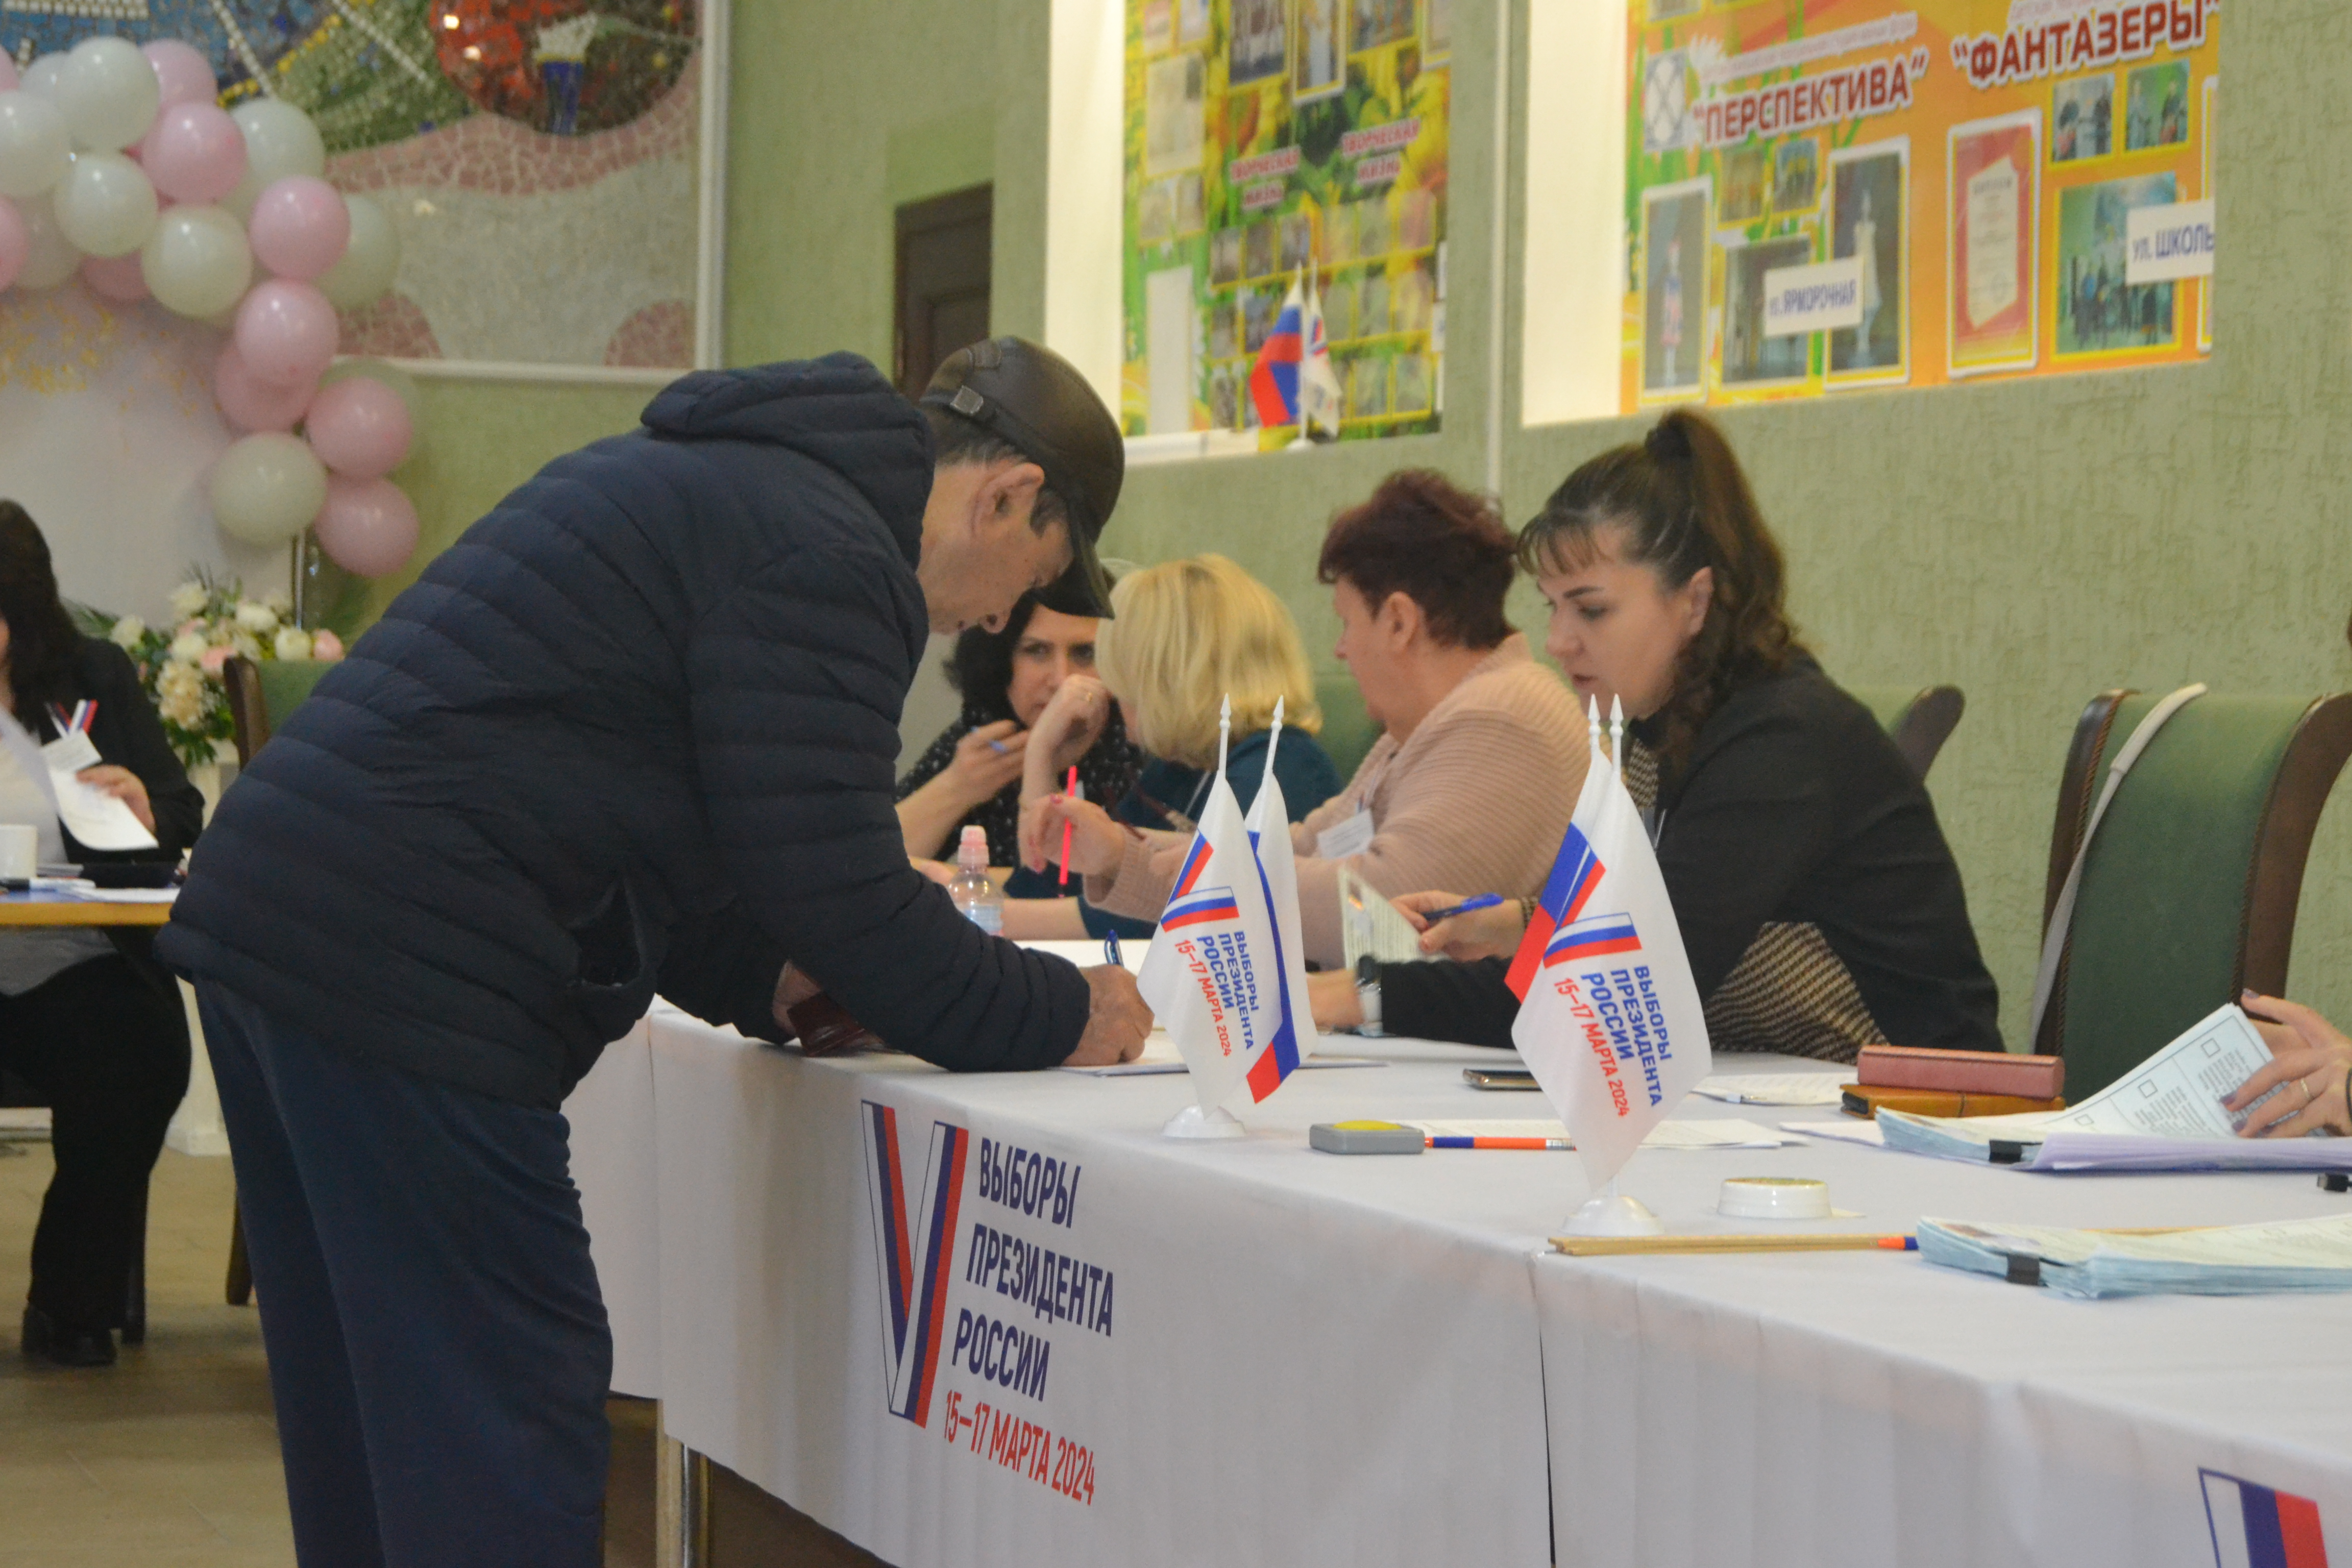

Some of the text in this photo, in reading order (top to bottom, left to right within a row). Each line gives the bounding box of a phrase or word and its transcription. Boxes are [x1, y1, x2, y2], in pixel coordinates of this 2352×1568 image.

[1196, 935, 1235, 1008] РОССИИ
[1197, 977, 1224, 1023] МАРТА
[1216, 1025, 1232, 1057] 2024
[1218, 933, 1254, 1049] ПРЕЗИДЕНТА
[1234, 931, 1260, 1011] ВЫБОРЫ
[1580, 972, 1634, 1059] РОССИИ
[1634, 966, 1673, 1060] ВЫБОРЫ
[1581, 1023, 1619, 1077] МАРТА
[1608, 1080, 1630, 1117] 2024
[1610, 969, 1662, 1105] ПРЕЗИДЕНТА
[980, 1137, 1083, 1228] ВЫБОРЫ
[966, 1223, 1114, 1337] ПРЕЗИДЕНТА
[952, 1308, 1050, 1402] РОССИИ
[988, 1410, 1051, 1485] МАРТА
[1051, 1437, 1095, 1506] 2024
